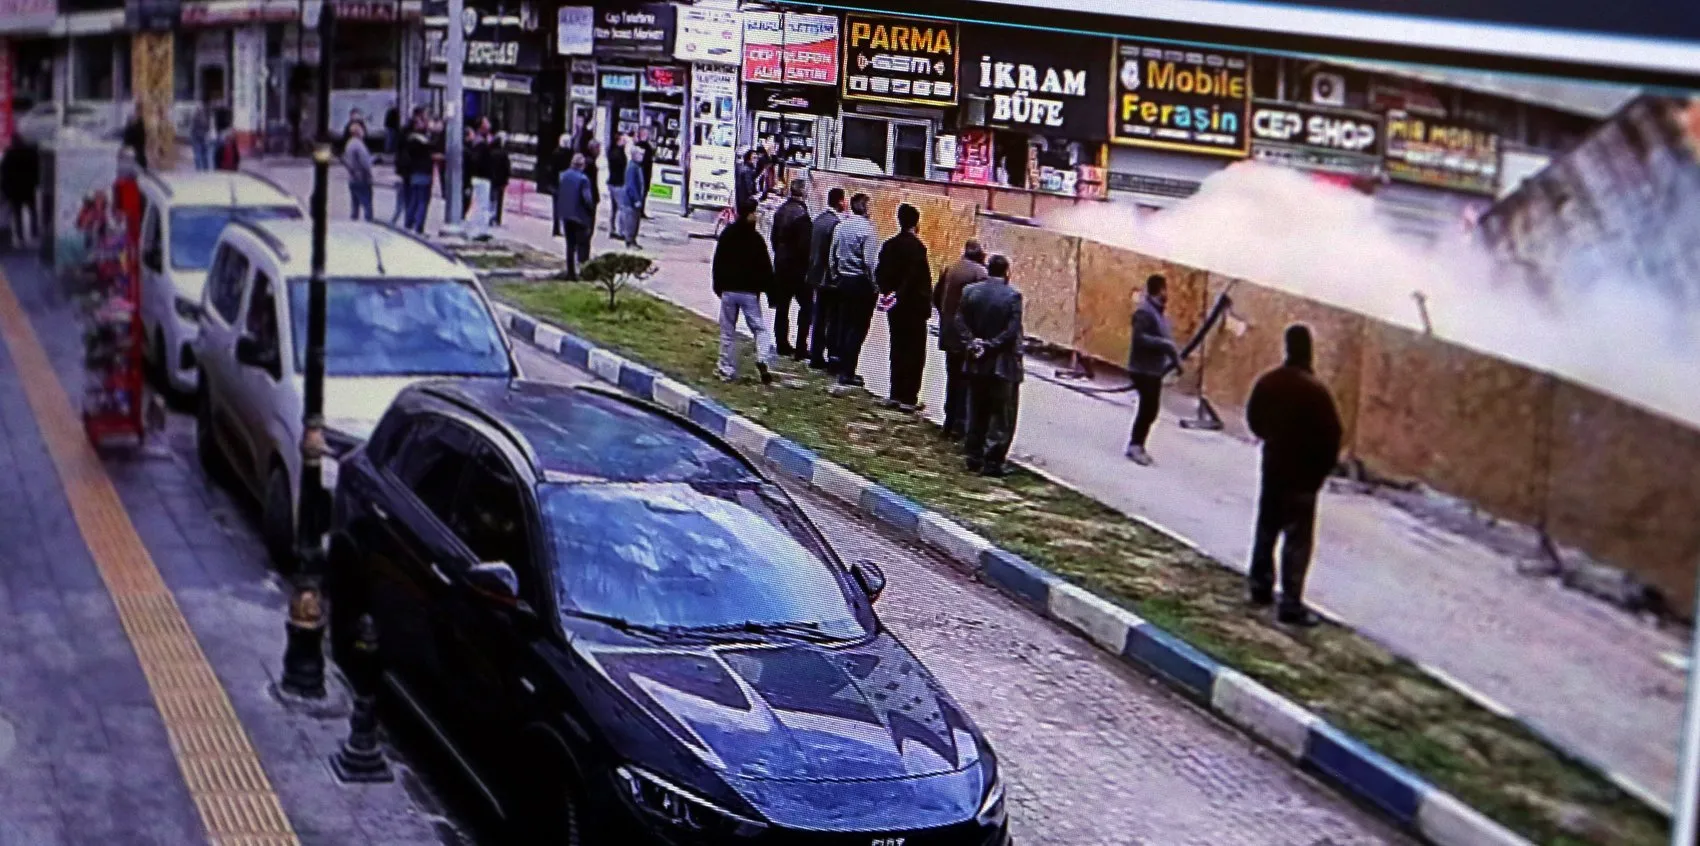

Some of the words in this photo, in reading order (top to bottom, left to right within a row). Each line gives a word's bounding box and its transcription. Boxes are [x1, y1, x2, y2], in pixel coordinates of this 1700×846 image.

[851, 22, 953, 55] PARMA
[980, 55, 1086, 97] İKRAM
[1147, 60, 1245, 98] Mobile
[992, 90, 1064, 127] BÜFE
[1252, 109, 1303, 139] CEP
[1307, 115, 1375, 149] SHOP
